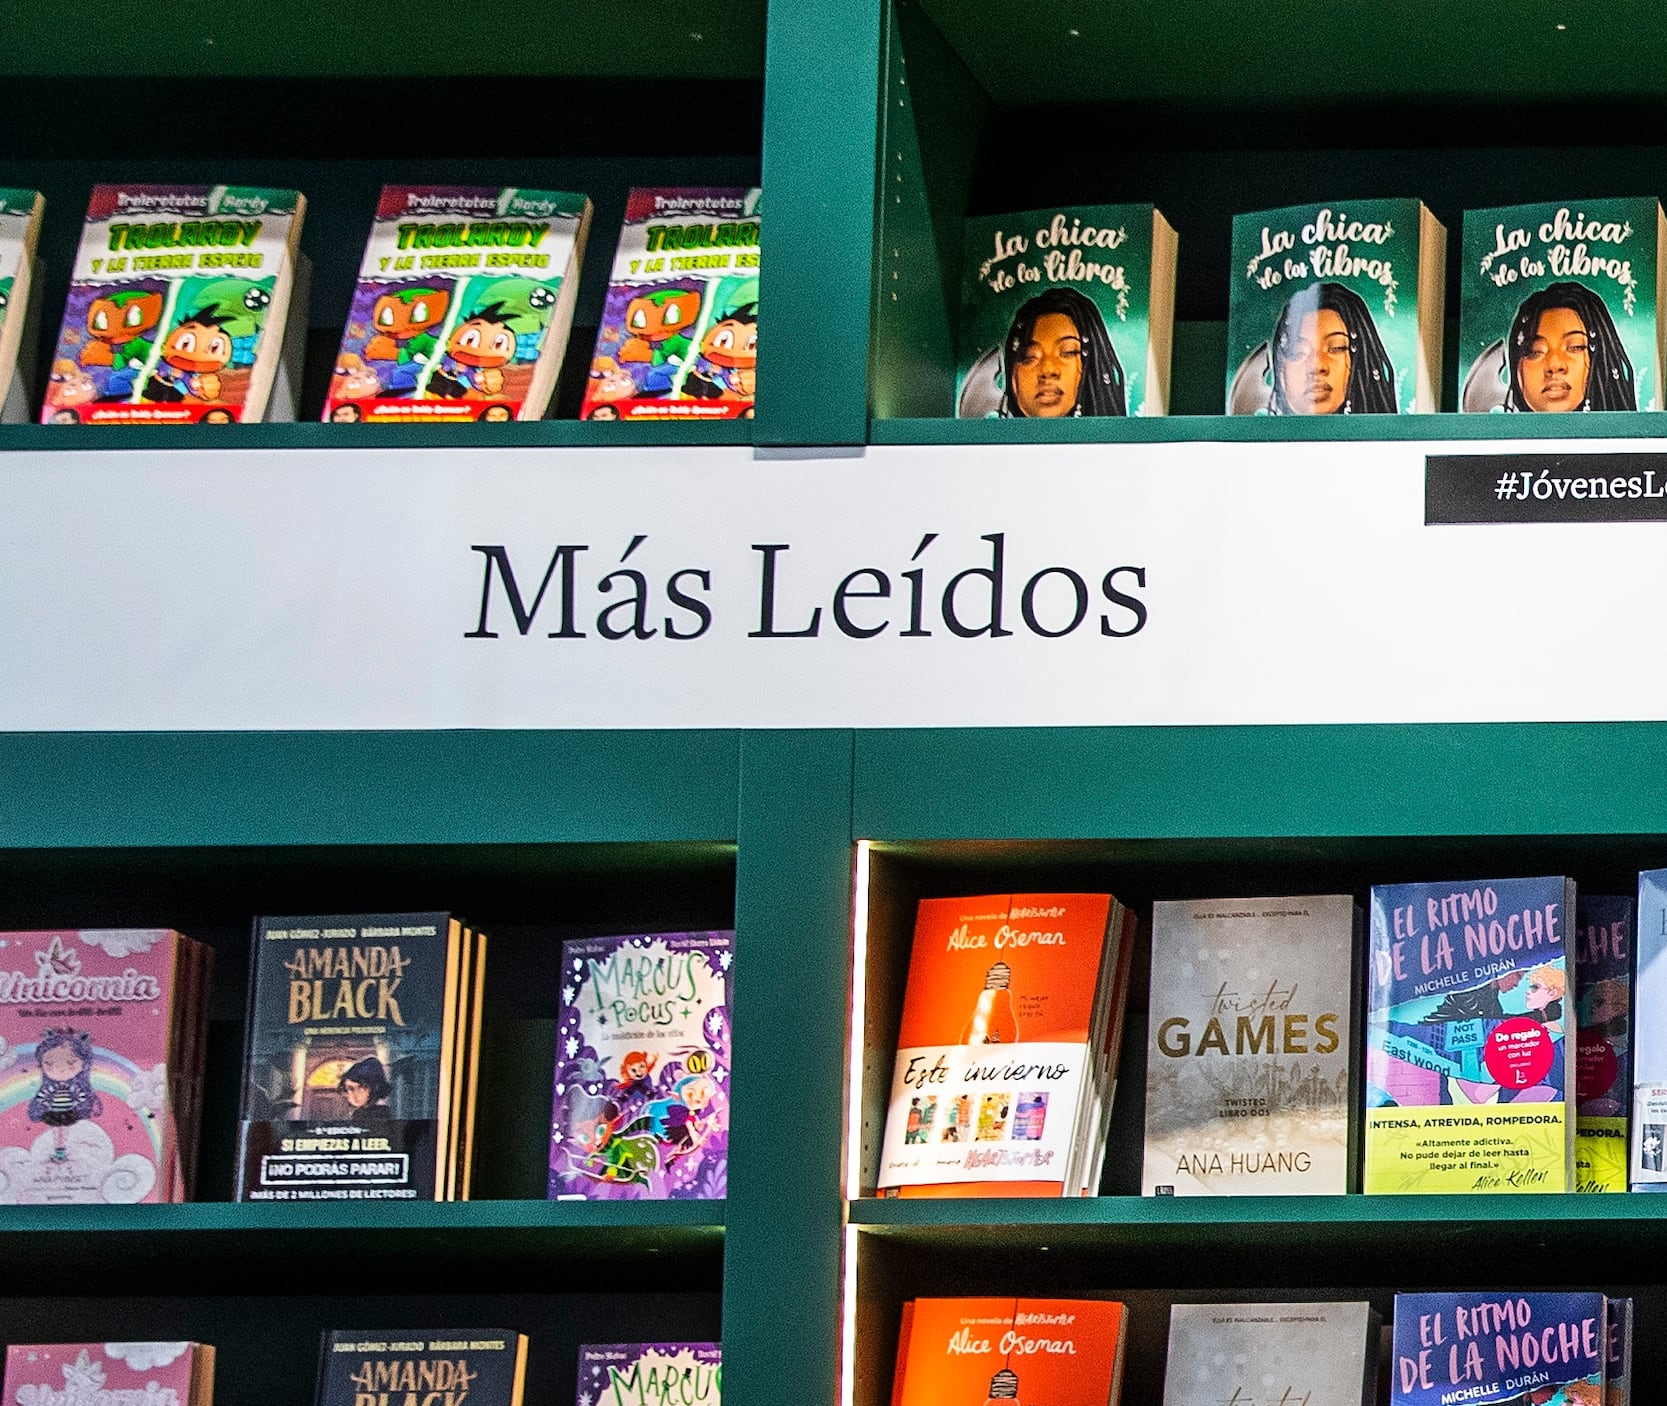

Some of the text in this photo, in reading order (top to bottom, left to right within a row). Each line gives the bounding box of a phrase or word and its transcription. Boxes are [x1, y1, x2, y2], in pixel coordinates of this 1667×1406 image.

[464, 532, 1148, 640] Más Leídos
[1157, 1014, 1339, 1058] GAMES
[1175, 1152, 1312, 1176] ANA HUANG
[1419, 1298, 1532, 1346] EL RITMO
[1401, 1320, 1599, 1392] DE LA NOCHE
[1440, 1370, 1549, 1406] MICHELLE DURÁN
